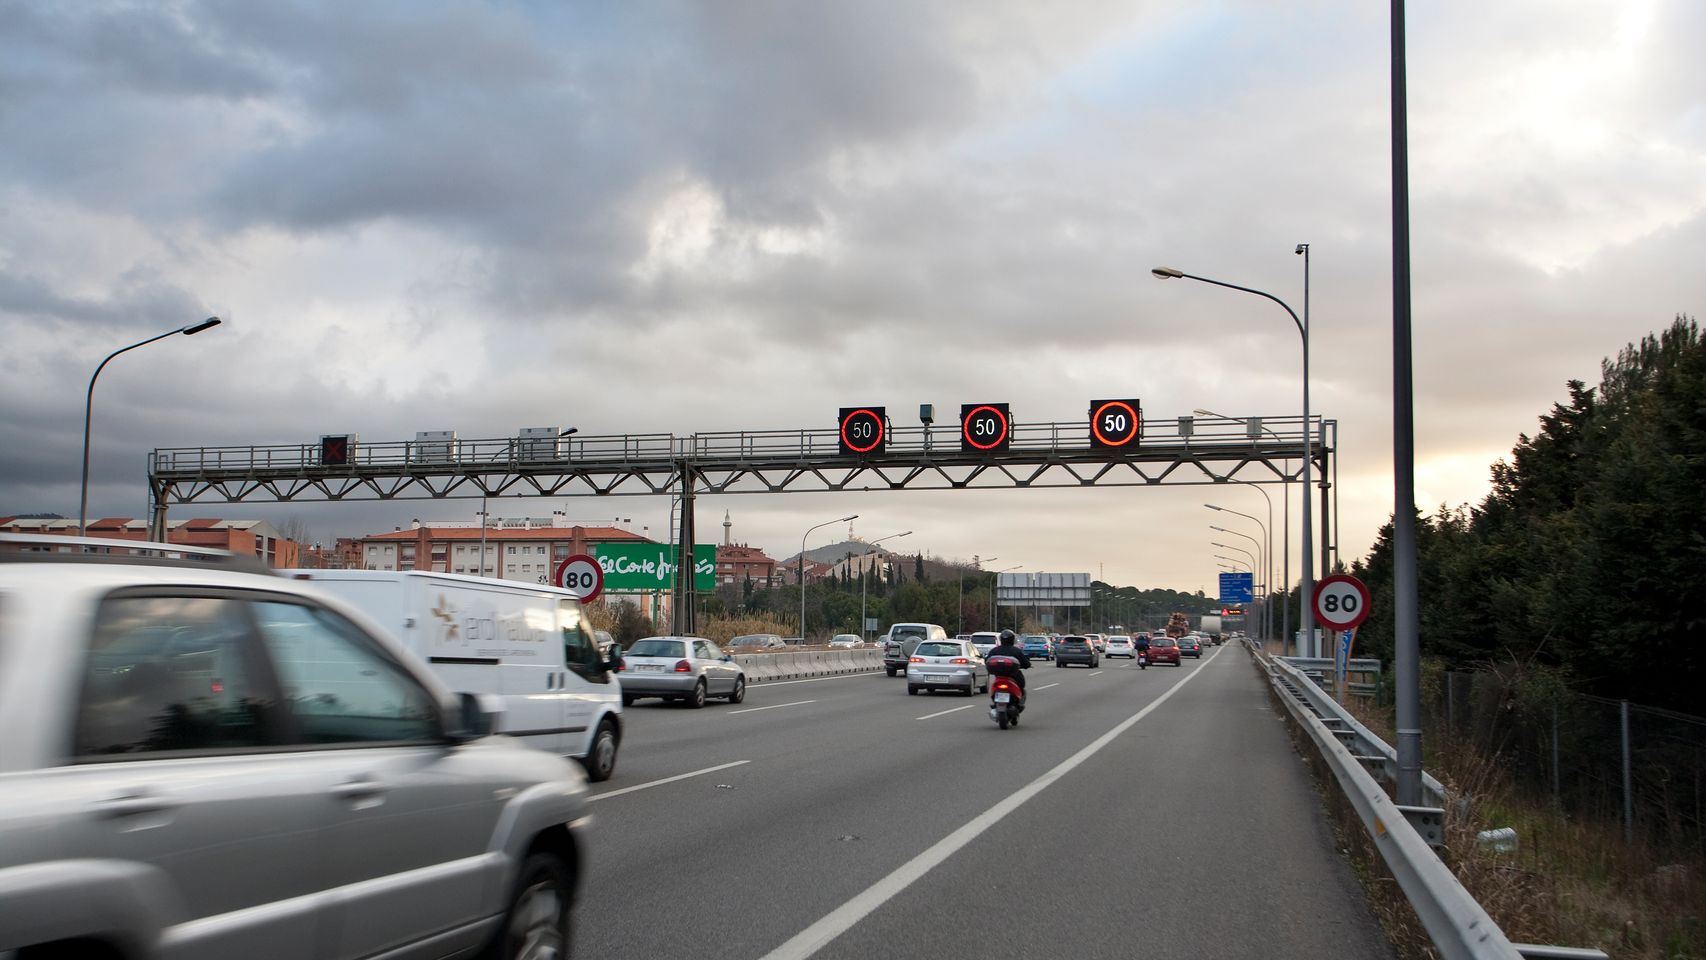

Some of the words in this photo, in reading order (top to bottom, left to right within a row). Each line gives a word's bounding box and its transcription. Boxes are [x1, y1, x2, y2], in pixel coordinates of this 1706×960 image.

[853, 422, 872, 438] 50
[975, 418, 995, 436] 50
[1104, 414, 1126, 432] 50
[597, 555, 615, 574] El
[615, 556, 655, 574] Corte
[566, 572, 593, 588] 80
[1324, 594, 1357, 612] 80
